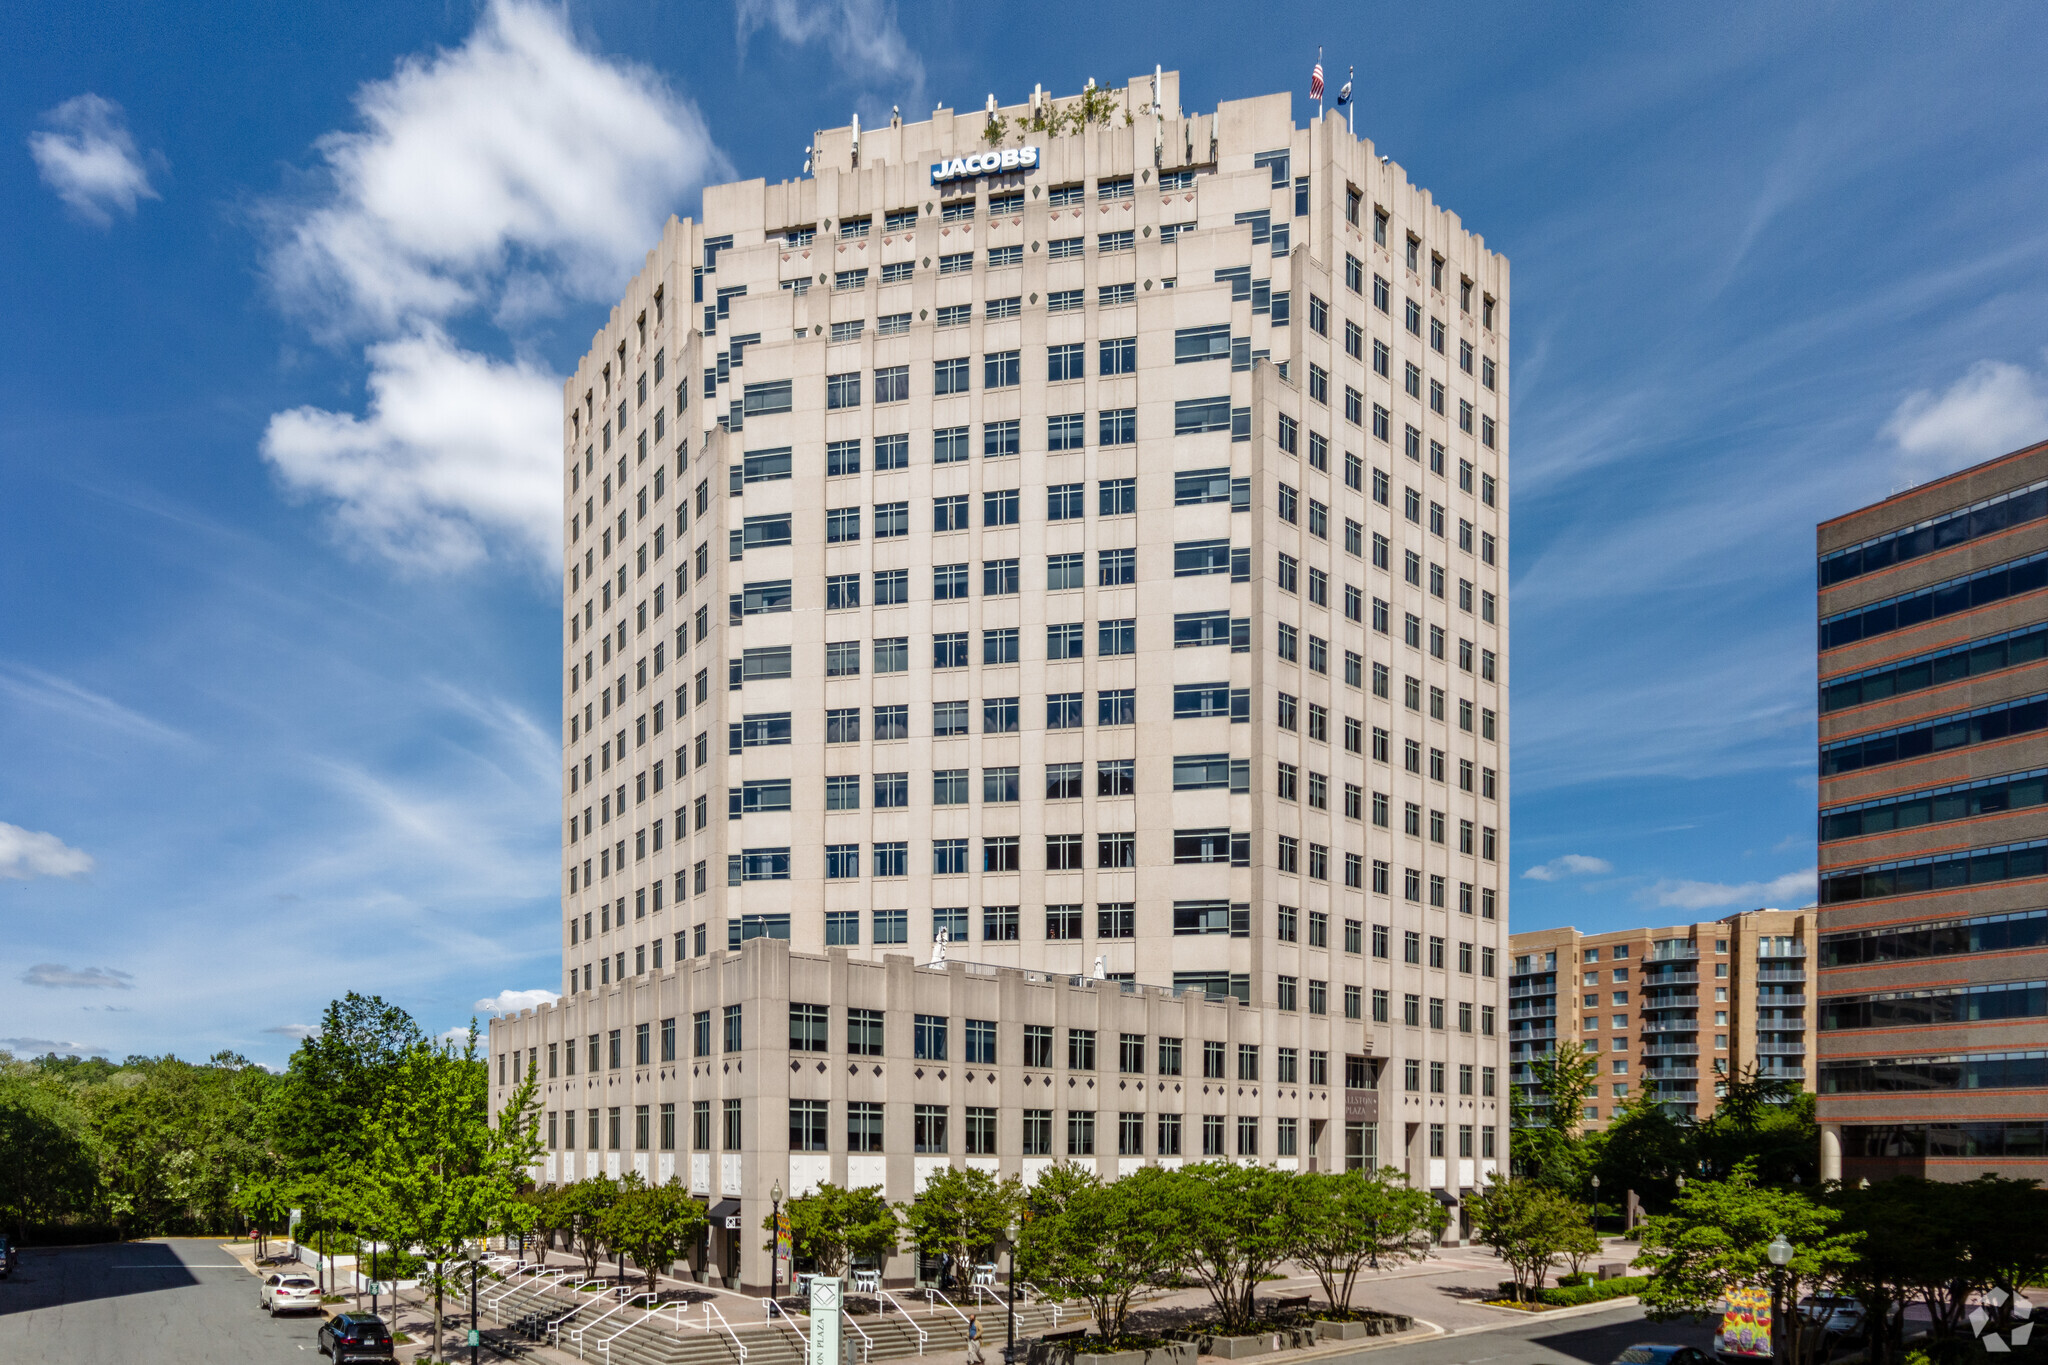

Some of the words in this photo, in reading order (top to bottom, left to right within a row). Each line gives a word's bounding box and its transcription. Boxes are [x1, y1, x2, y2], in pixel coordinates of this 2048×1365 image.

[933, 146, 1037, 180] JACOBS
[1345, 1106, 1367, 1115] PLAZA
[816, 1318, 824, 1348] PLAZA
